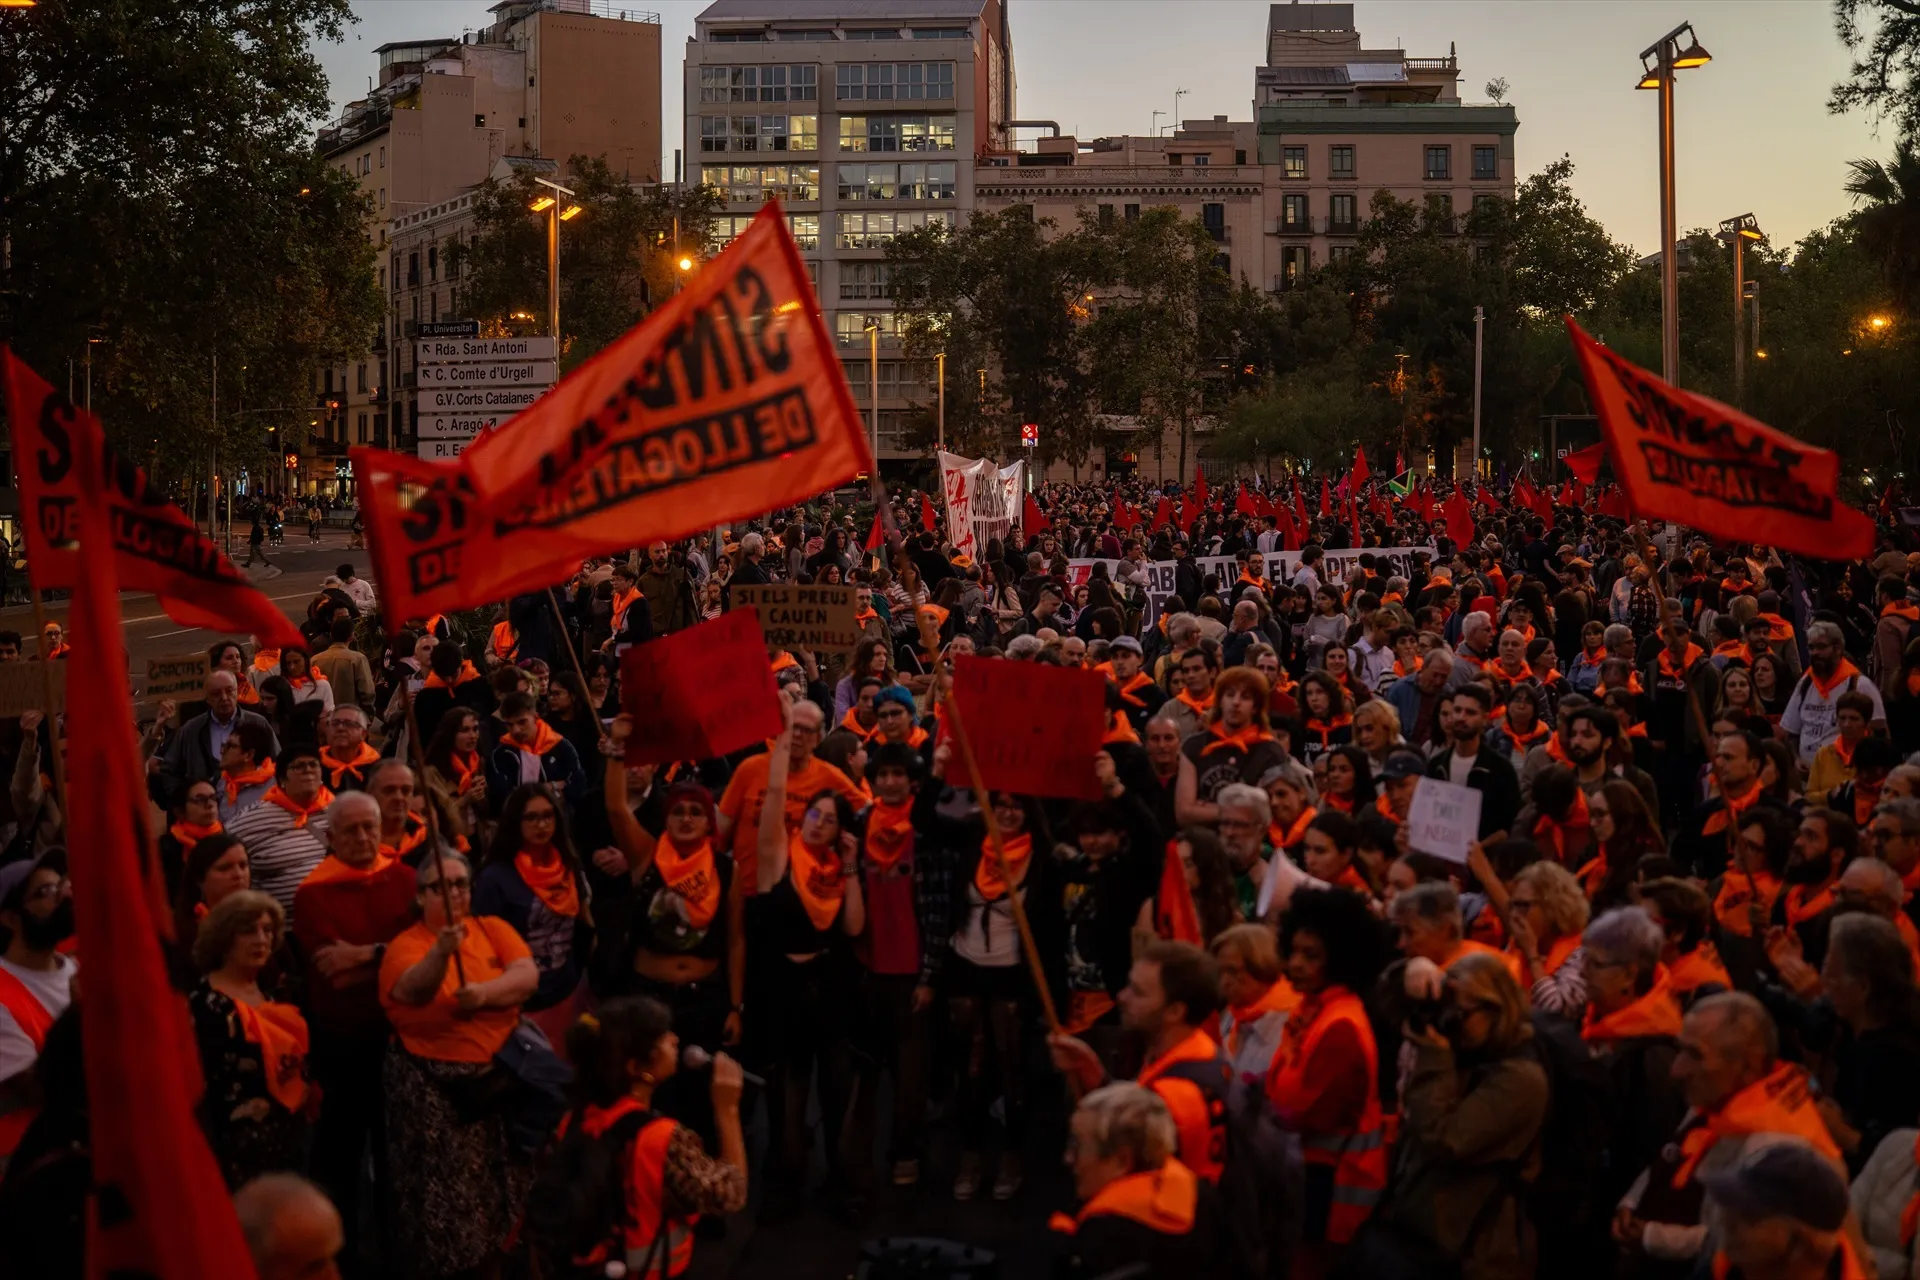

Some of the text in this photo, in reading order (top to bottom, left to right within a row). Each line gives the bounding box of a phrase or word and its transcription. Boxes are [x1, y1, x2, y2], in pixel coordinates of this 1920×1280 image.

[422, 324, 473, 334] Pl. Universitat
[435, 341, 528, 355] Rda. Sant Antoni
[435, 369, 447, 380] C.
[450, 368, 486, 380] Comte
[486, 391, 535, 405] Catalanes
[435, 418, 483, 433] C. Aragó
[435, 445, 449, 456] Pl.
[1268, 558, 1288, 585] EL
[737, 589, 848, 605] SI ELS PREUS
[769, 607, 828, 624] CAUEN
